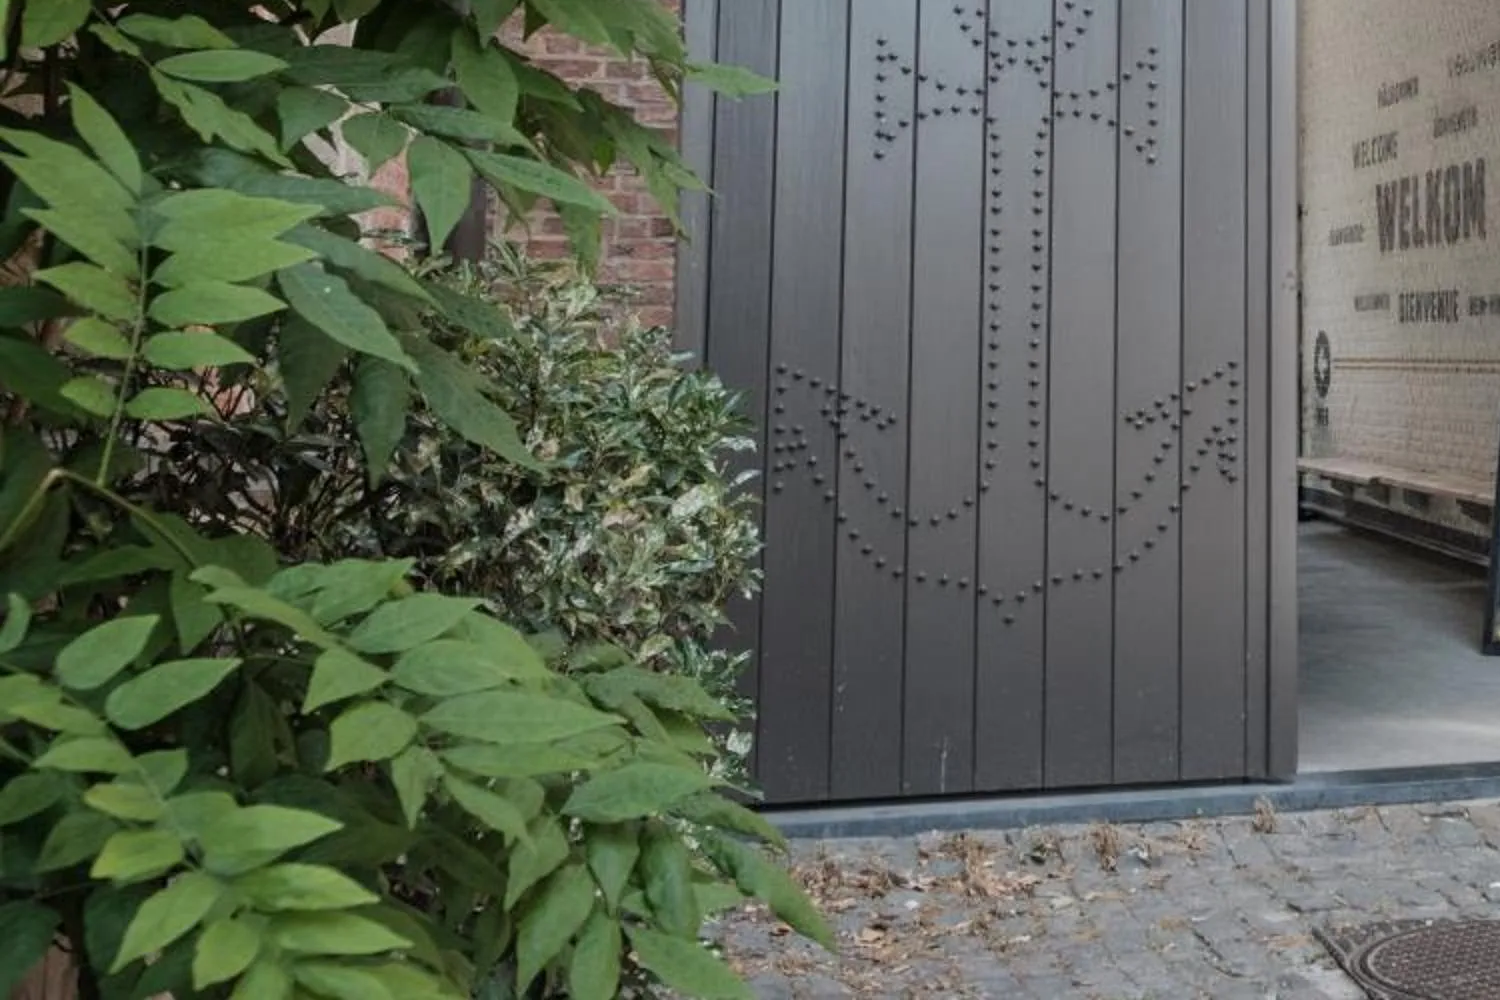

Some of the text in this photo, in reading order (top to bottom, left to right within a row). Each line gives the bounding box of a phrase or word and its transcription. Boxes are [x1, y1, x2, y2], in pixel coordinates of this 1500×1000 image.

[1353, 130, 1399, 168] WELCOME
[1375, 157, 1487, 255] WELKOM
[1399, 288, 1459, 323] BIENVENUE
